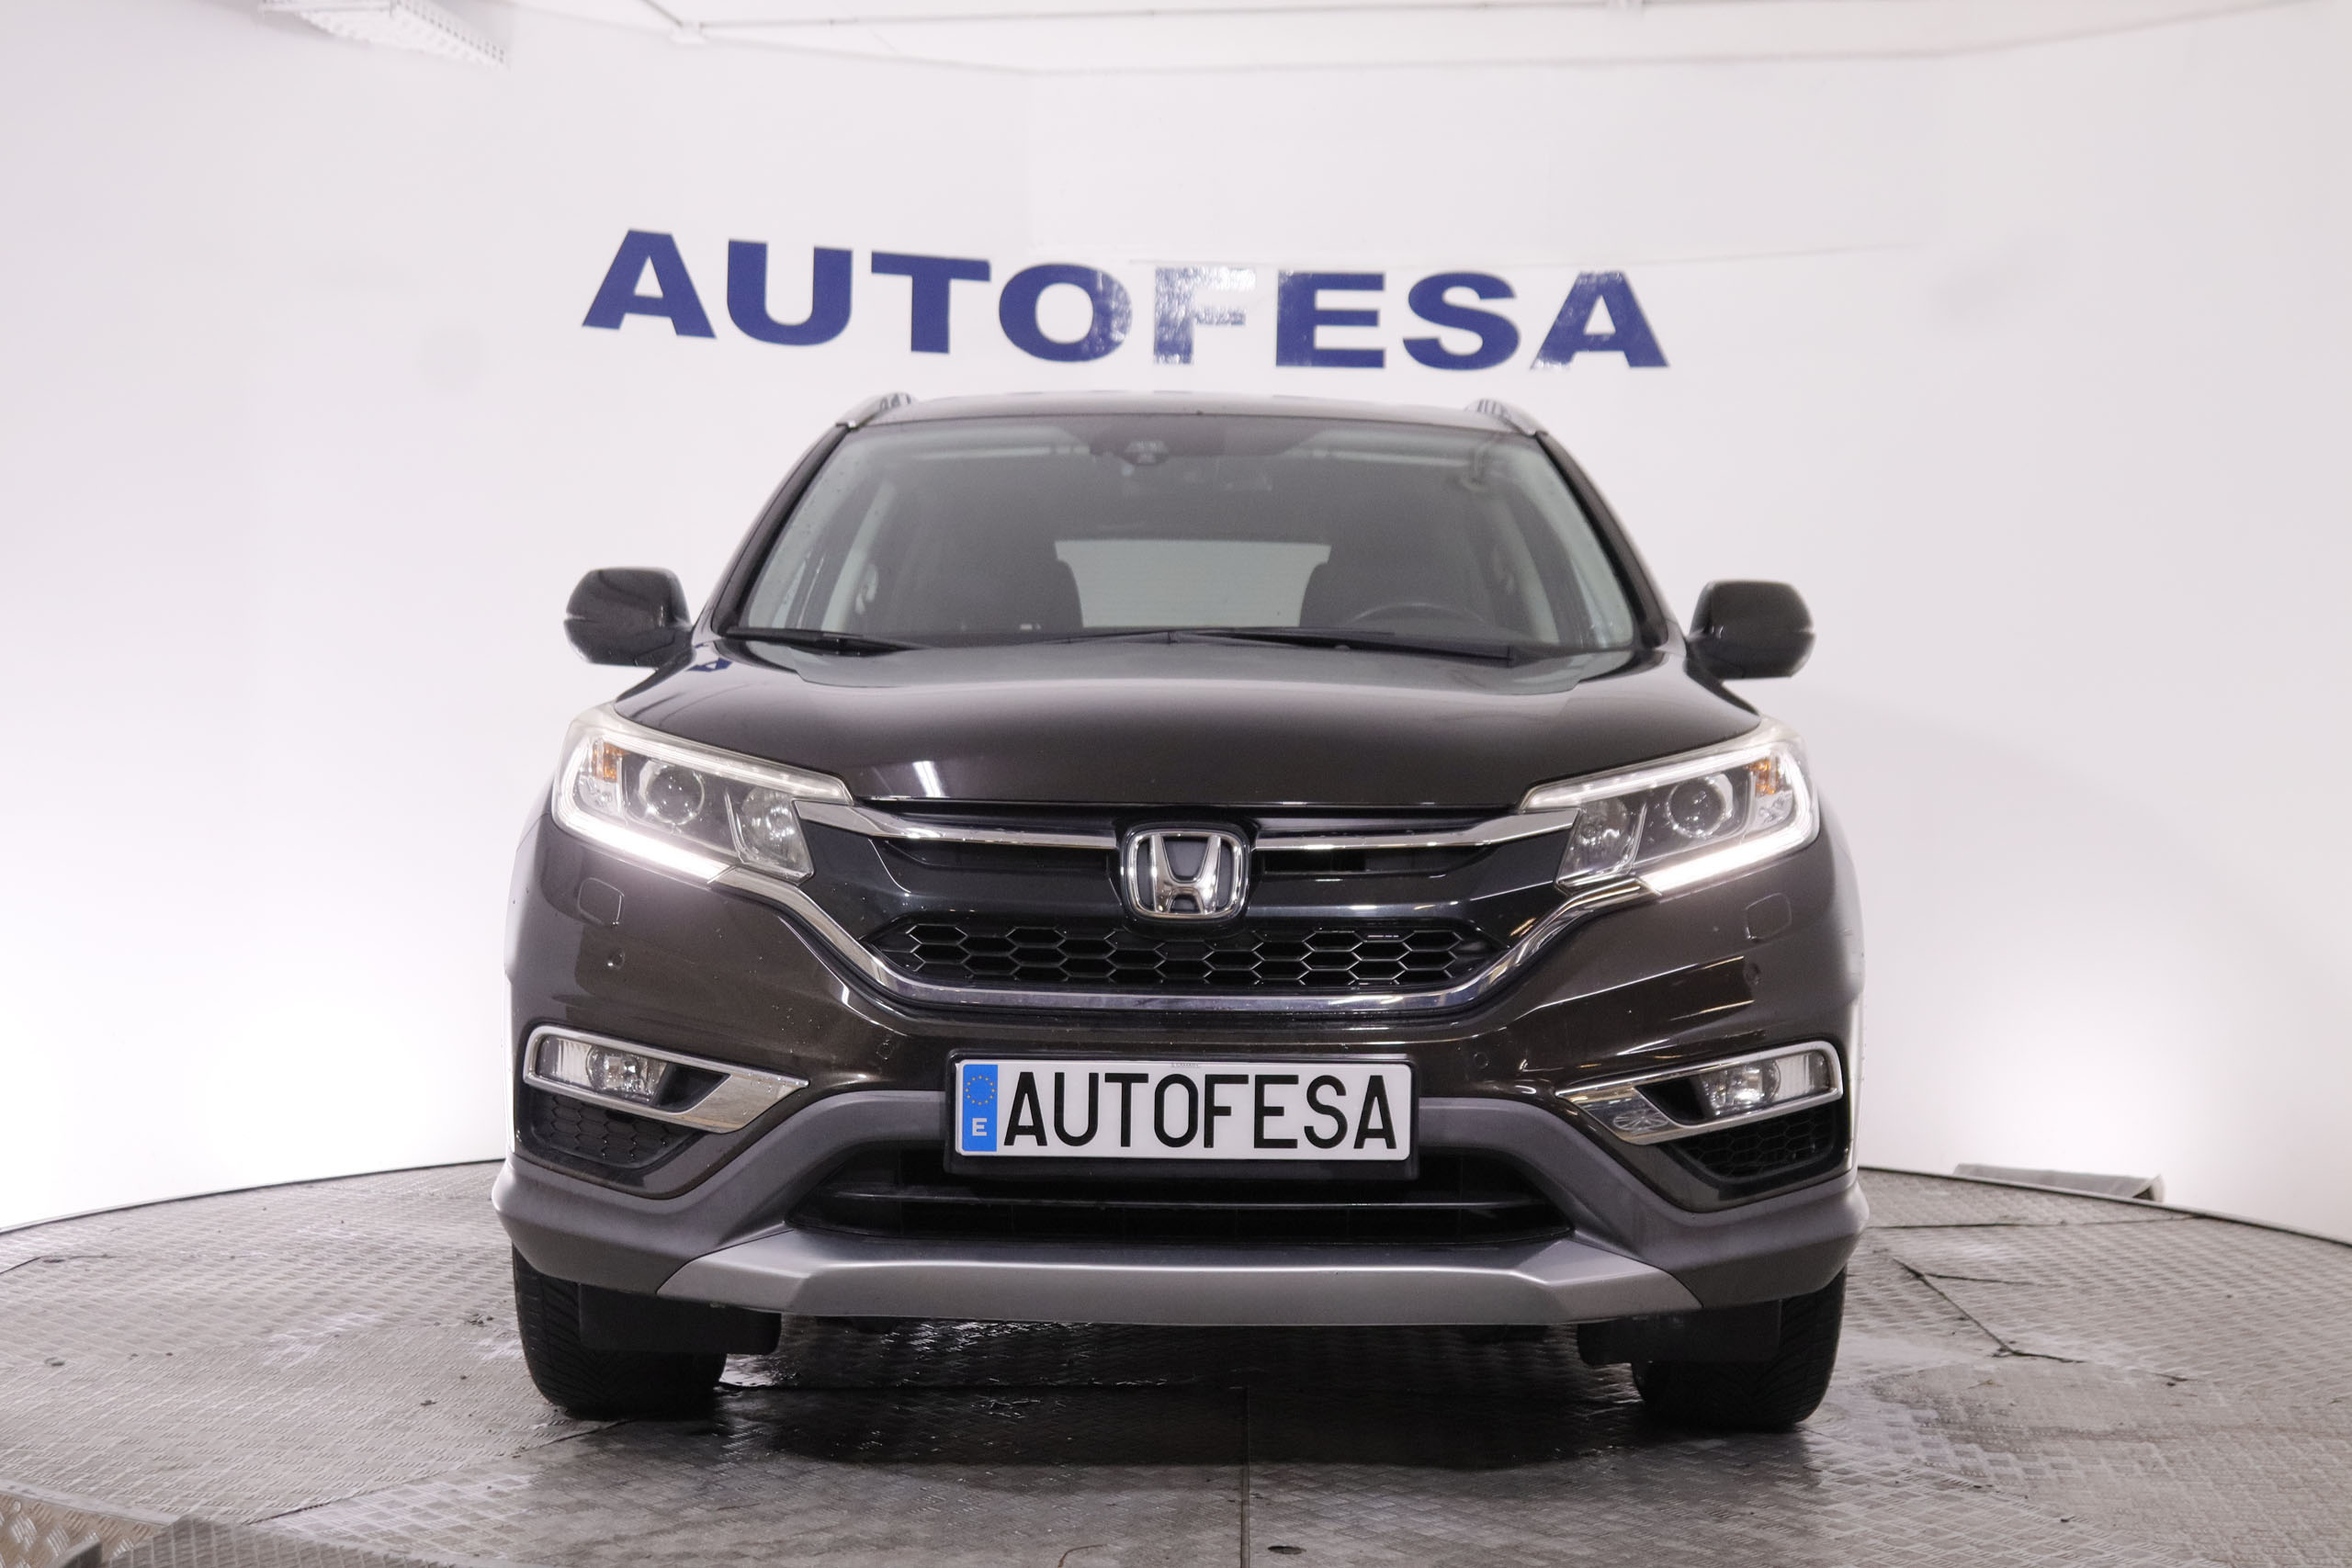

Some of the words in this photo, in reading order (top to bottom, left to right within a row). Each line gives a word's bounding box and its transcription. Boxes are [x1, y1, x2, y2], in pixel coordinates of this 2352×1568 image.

[582, 230, 1668, 370] AUTOFESA
[972, 1118, 988, 1136] E
[1003, 1071, 1397, 1150] AUTOFESA
